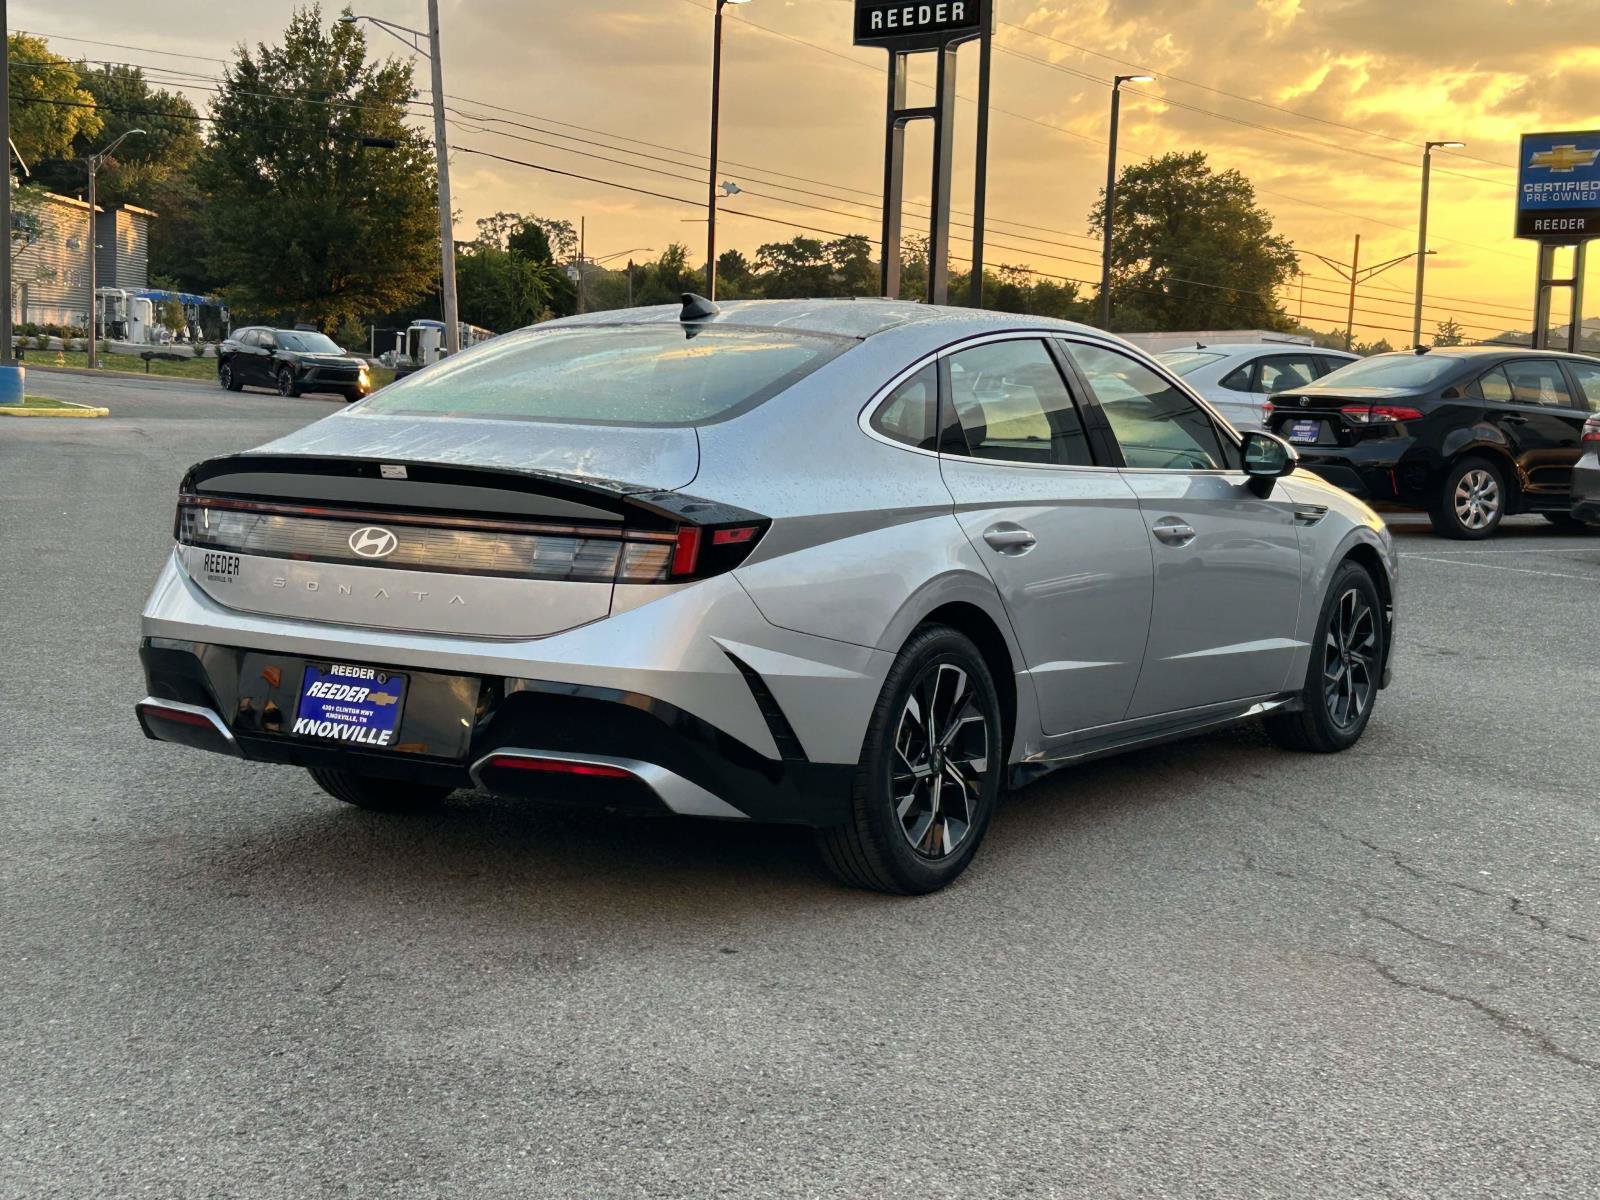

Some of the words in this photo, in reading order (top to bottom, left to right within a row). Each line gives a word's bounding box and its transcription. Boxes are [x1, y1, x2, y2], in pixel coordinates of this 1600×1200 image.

[871, 1, 965, 30] REEDER
[1523, 181, 1600, 193] CERTIFIED
[1526, 191, 1597, 203] PRE-OWNED
[1535, 219, 1585, 231] REEDER
[204, 553, 240, 576] REEDER
[273, 577, 465, 605] SONATA
[331, 664, 375, 680] REEDER
[306, 681, 370, 703] REEDER
[335, 706, 360, 714] CLINTON
[360, 709, 374, 717] HWY
[292, 717, 393, 746] KNOXVILLE
